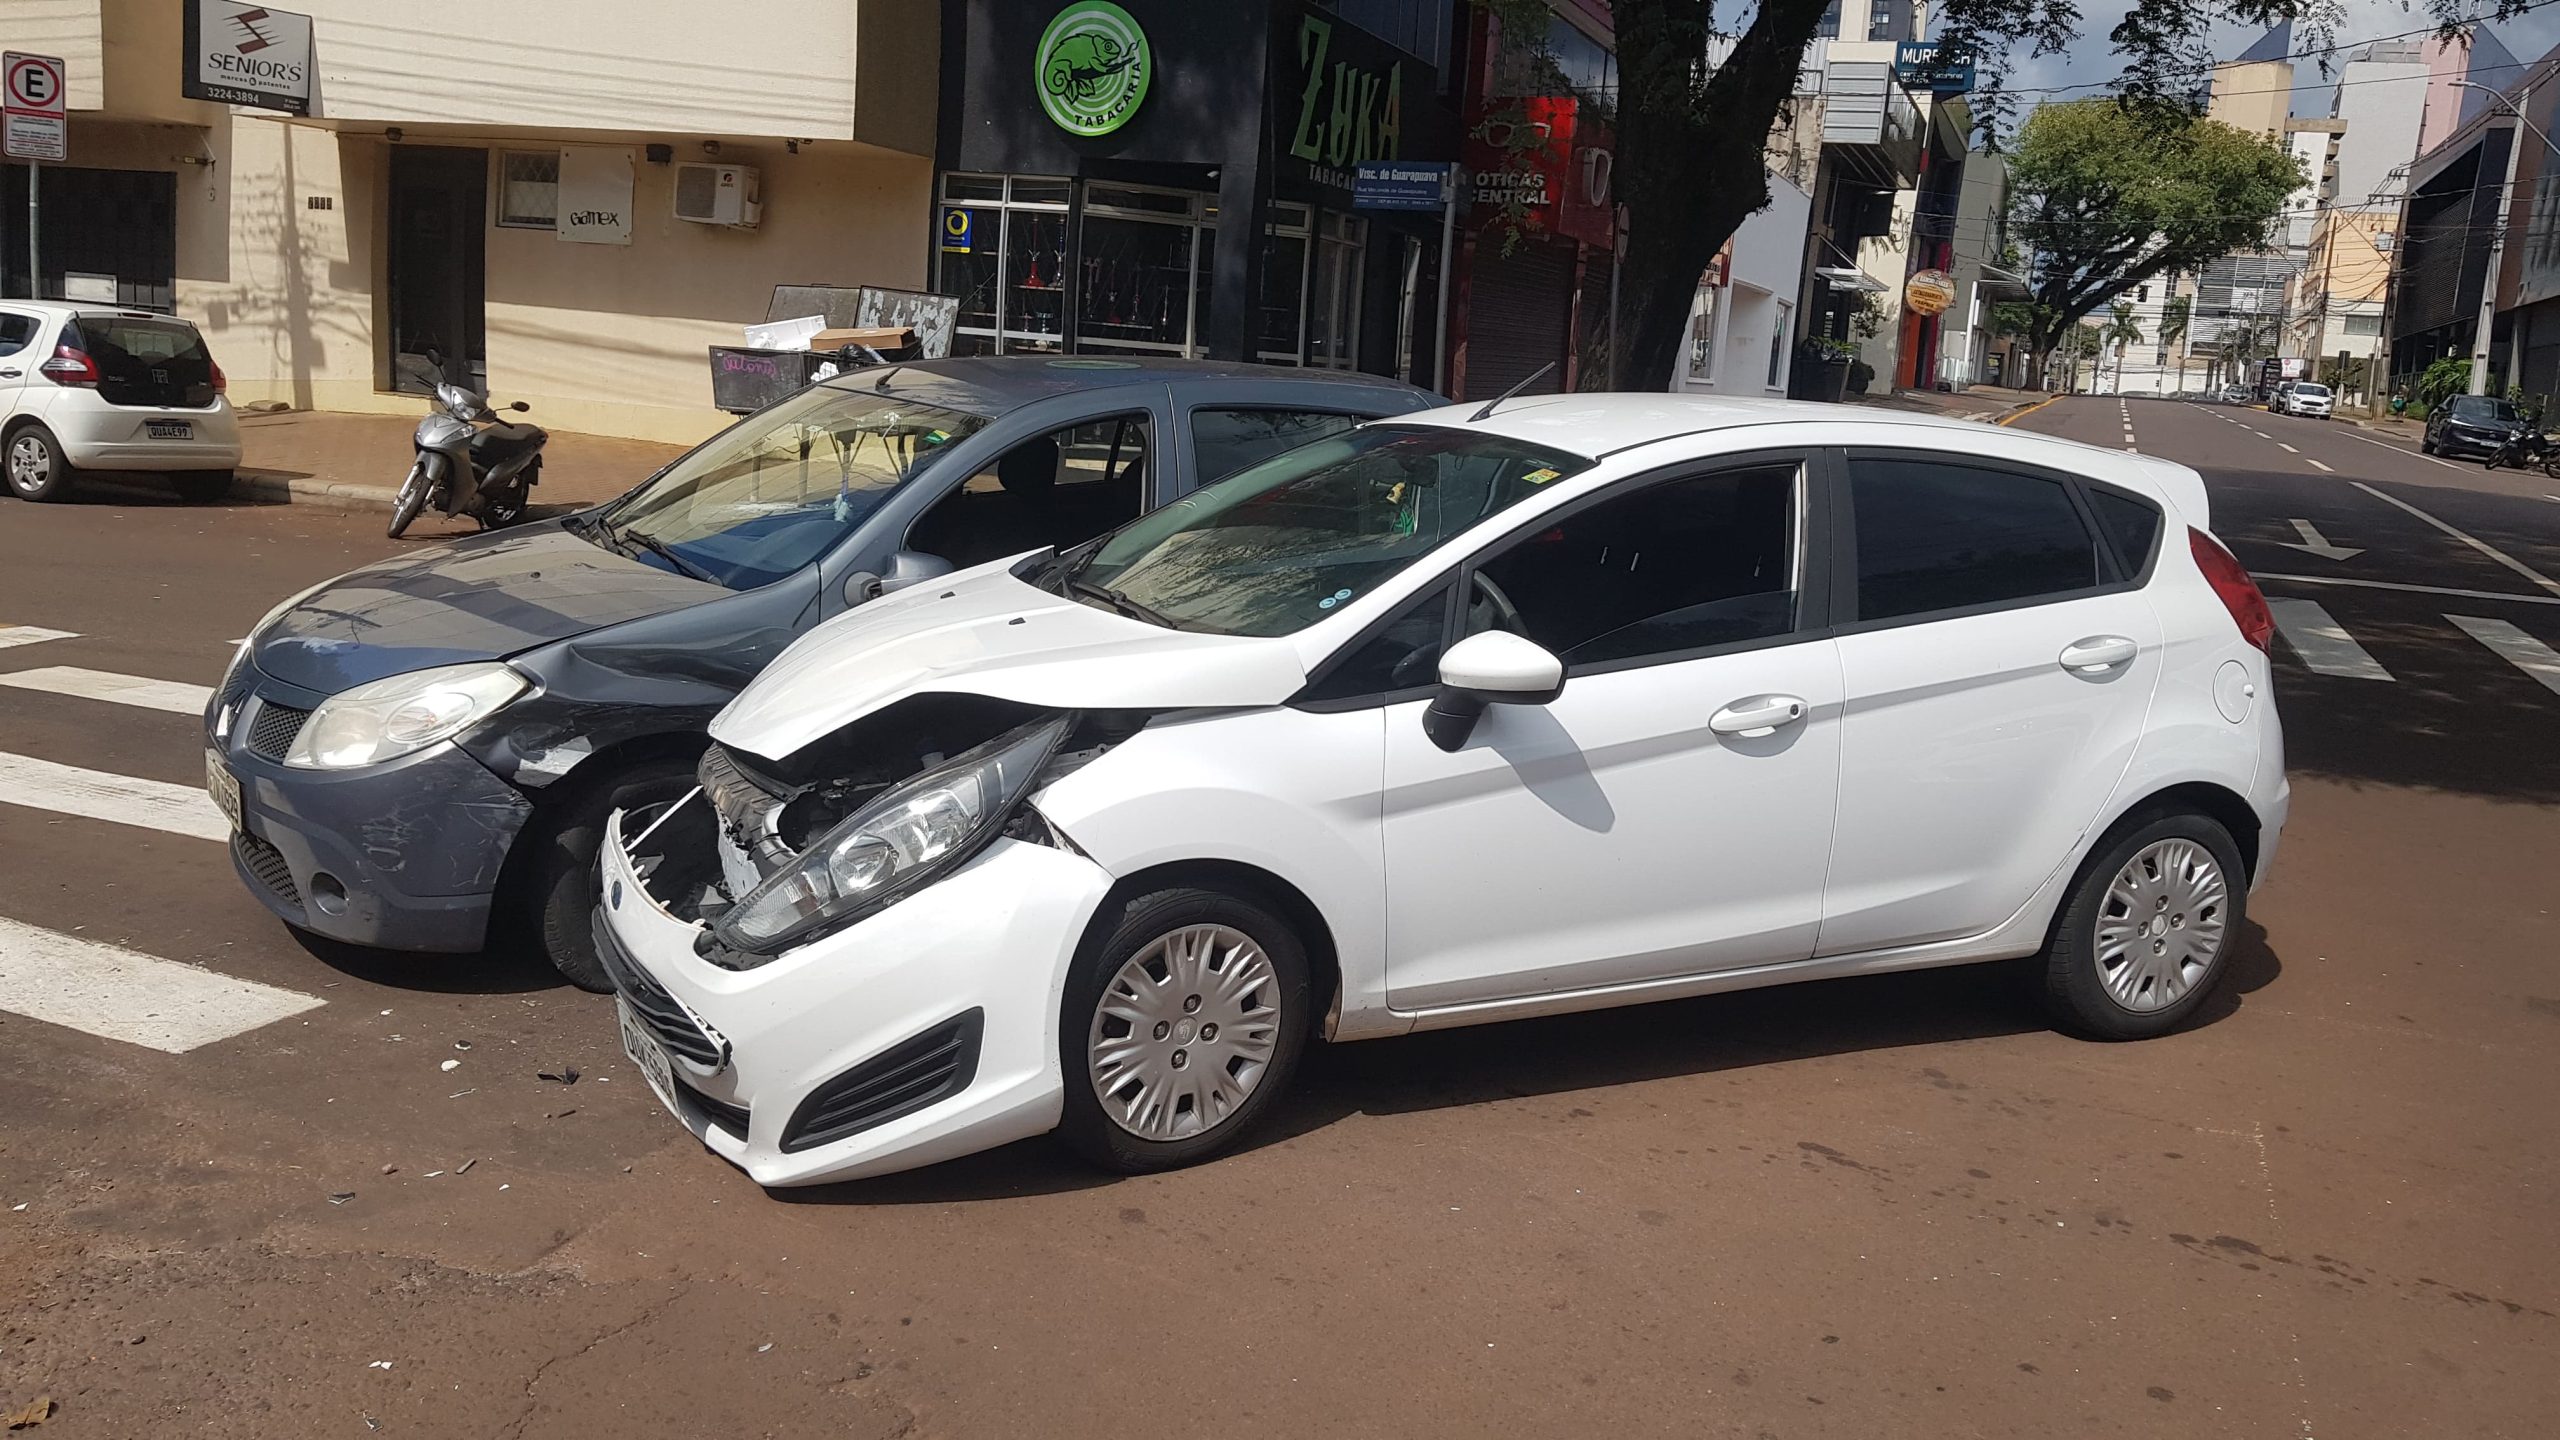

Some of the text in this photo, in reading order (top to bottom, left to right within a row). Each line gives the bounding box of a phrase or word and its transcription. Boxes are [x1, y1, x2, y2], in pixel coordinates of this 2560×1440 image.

[208, 52, 302, 82] SENIOR'S
[1901, 47, 1971, 65] MURCH
[25, 68, 45, 99] E
[207, 87, 259, 104] 3224-3894
[1074, 62, 1142, 128] TABACARIA
[1290, 13, 1401, 168] ZUKA
[1359, 167, 1438, 183] Visc. de Guarapuava
